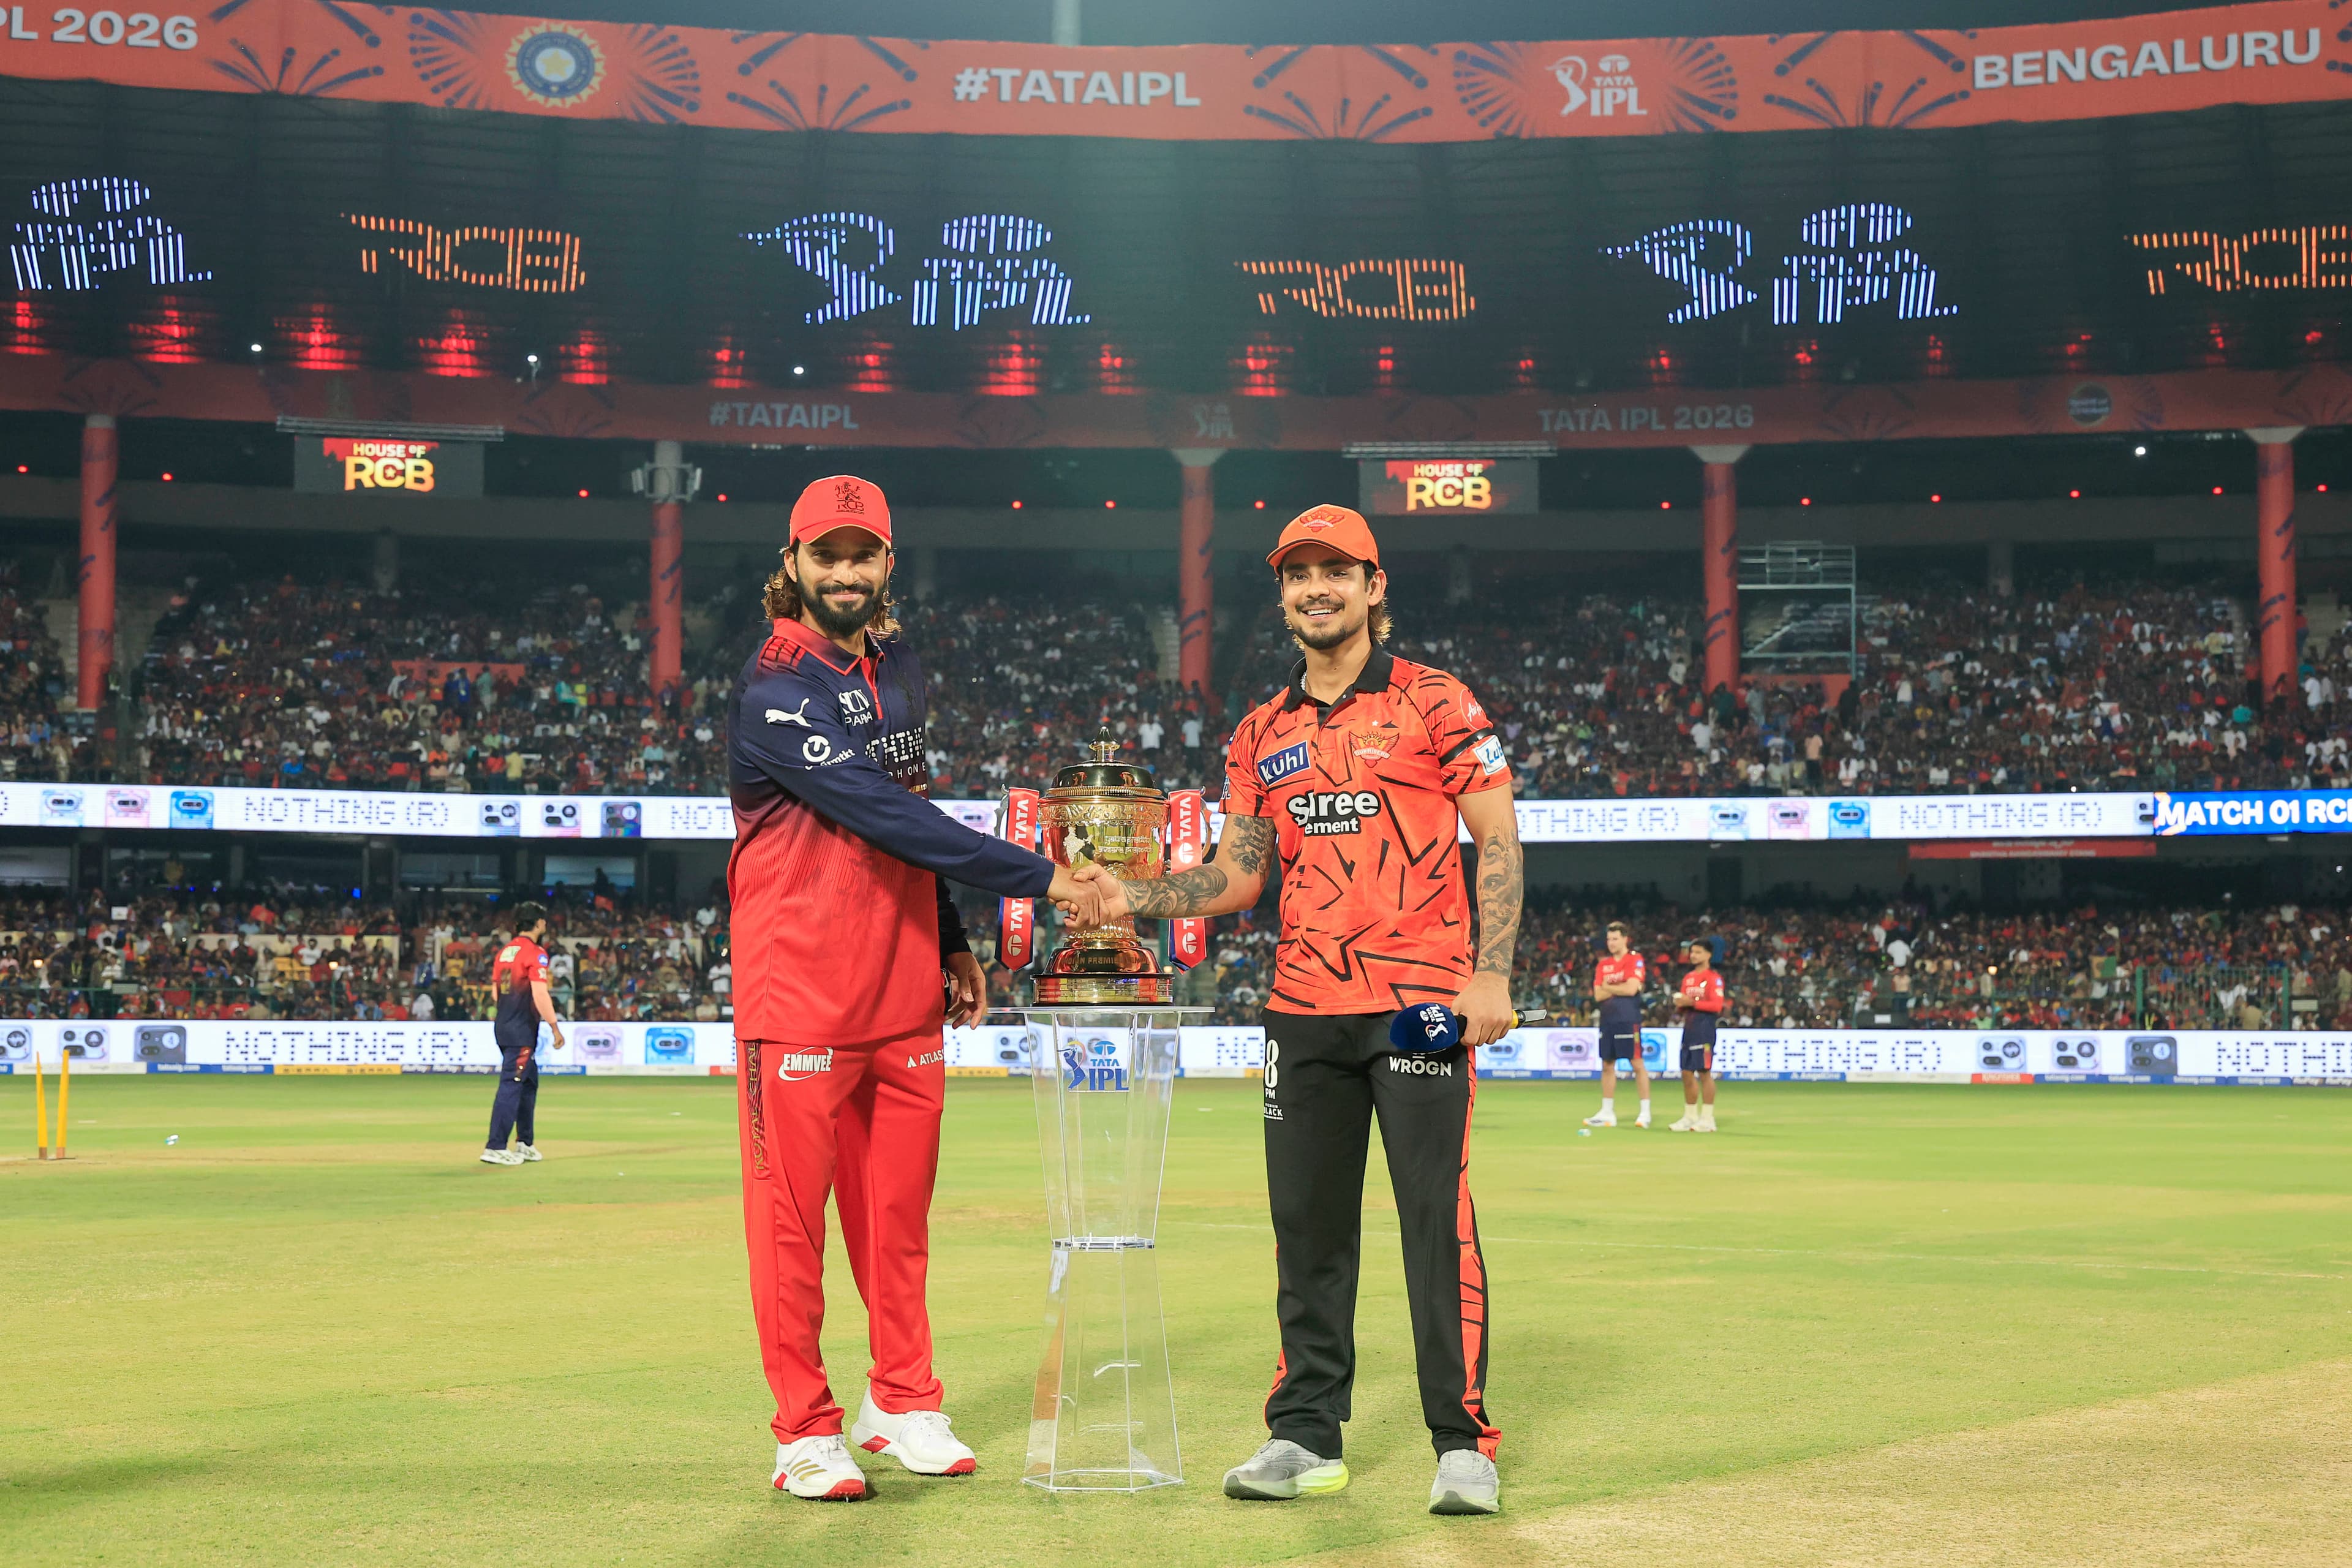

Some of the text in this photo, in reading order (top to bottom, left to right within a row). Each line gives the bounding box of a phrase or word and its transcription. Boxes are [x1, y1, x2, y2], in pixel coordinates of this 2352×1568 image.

[52, 8, 198, 50] 2026
[1973, 28, 2321, 89] BENGALURU
[953, 67, 1201, 107] #TATAIPL
[1593, 75, 1634, 87] TATA
[1590, 88, 1648, 116] IPL
[709, 402, 859, 429] #TATAIPL
[1537, 404, 1754, 432] TATA IPL 2026
[353, 443, 426, 458] HOUSE OF
[344, 456, 434, 492] RCB
[1414, 464, 1483, 477] HOUSE OF
[836, 499, 865, 511] RCB
[1407, 477, 1492, 511] RCB
[246, 796, 396, 826] NOTHING
[1014, 799, 1029, 842] TATA
[1180, 796, 1191, 840] TATA
[1900, 802, 2049, 830] NOTHING
[2157, 800, 2264, 827] MATCH
[2269, 799, 2300, 824] 01
[1305, 816, 1359, 835] ement
[1011, 898, 1024, 932] TAT
[1430, 1004, 1446, 1022] IPL
[226, 1031, 404, 1061] NOTHING
[2217, 1041, 2352, 1073] NOTHI
[783, 1054, 833, 1072] EMMVEE
[1090, 1058, 1120, 1067] TATA
[1265, 1039, 1280, 1088] 8
[1389, 1056, 1452, 1077] WROGN
[1088, 1068, 1129, 1091] IPL
[1265, 1088, 1276, 1099] PM
